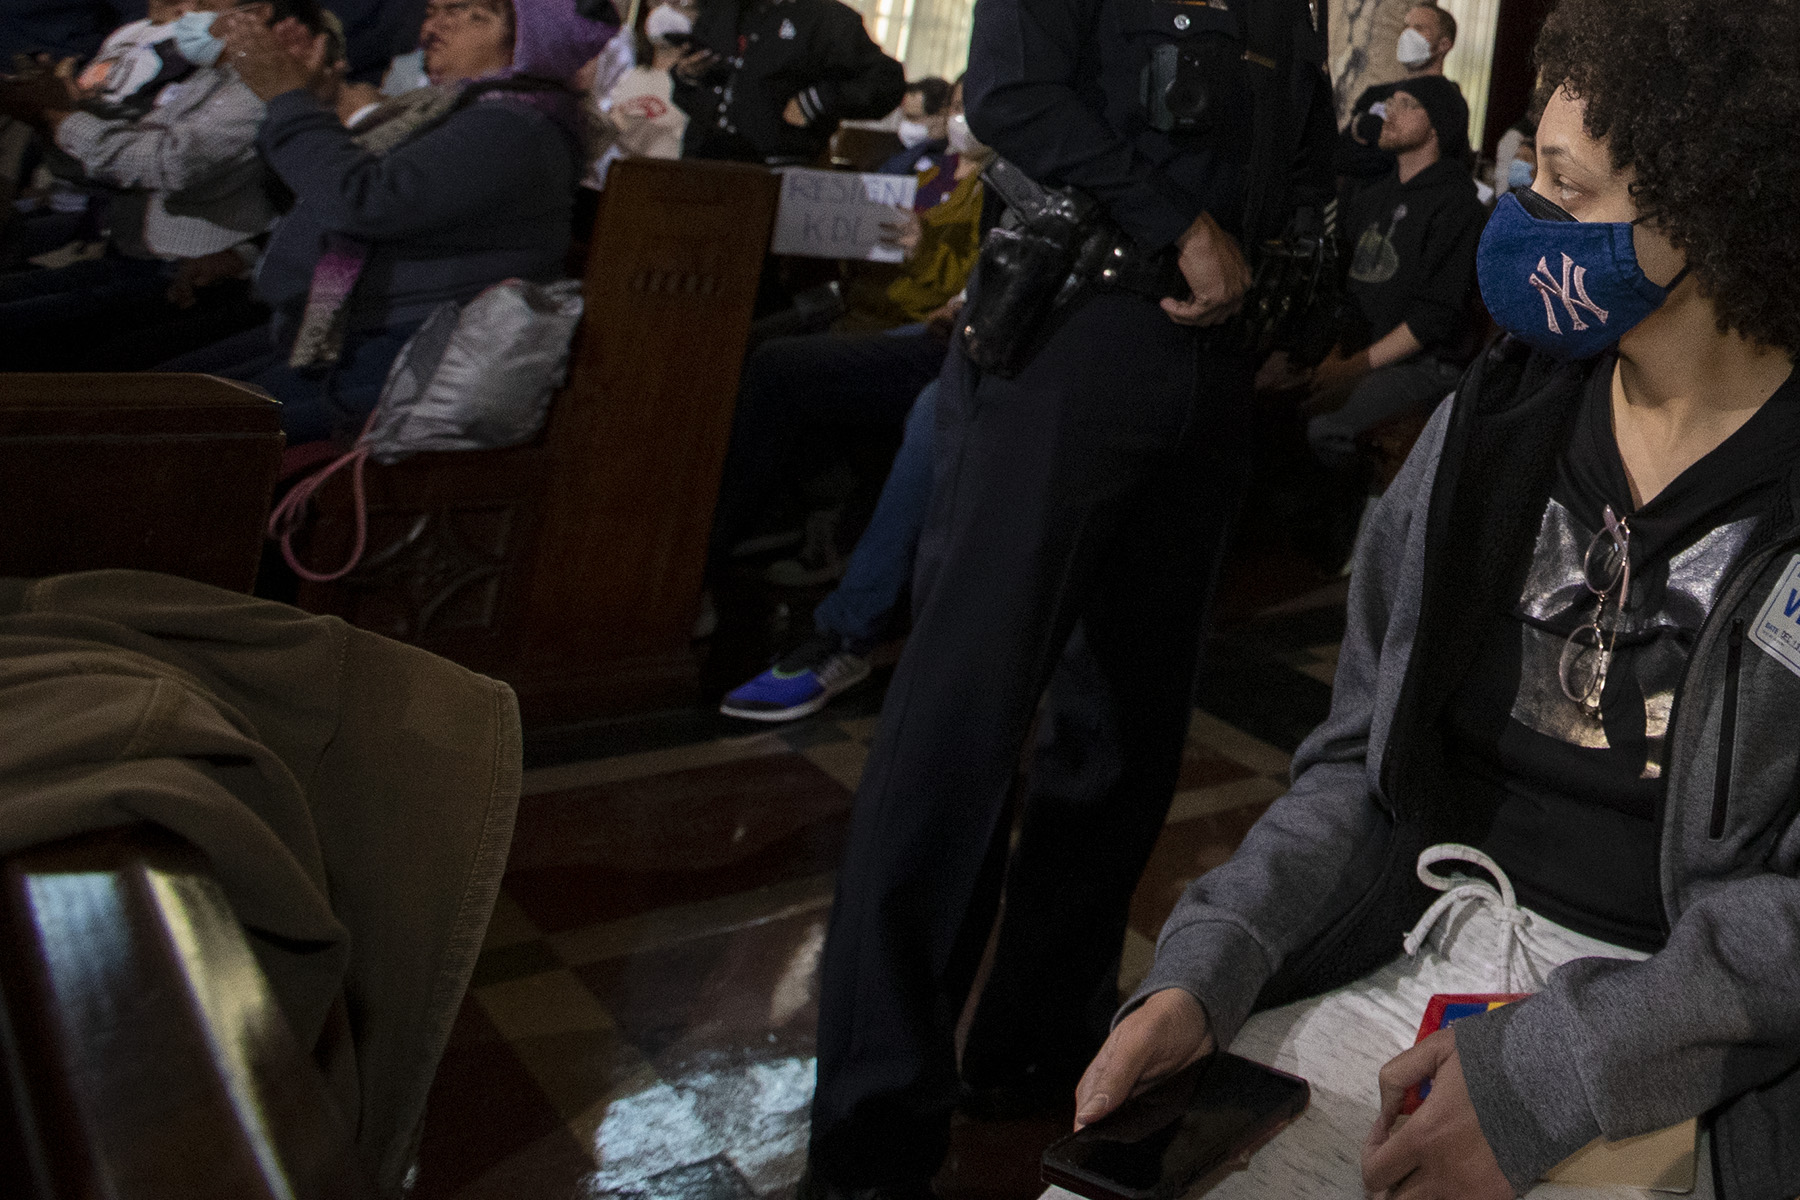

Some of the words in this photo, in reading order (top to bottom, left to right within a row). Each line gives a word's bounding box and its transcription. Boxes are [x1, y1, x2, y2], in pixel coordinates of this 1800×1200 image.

[1529, 251, 1609, 335] NY
[1765, 621, 1779, 636] DATE
[1780, 629, 1793, 644] DEC
